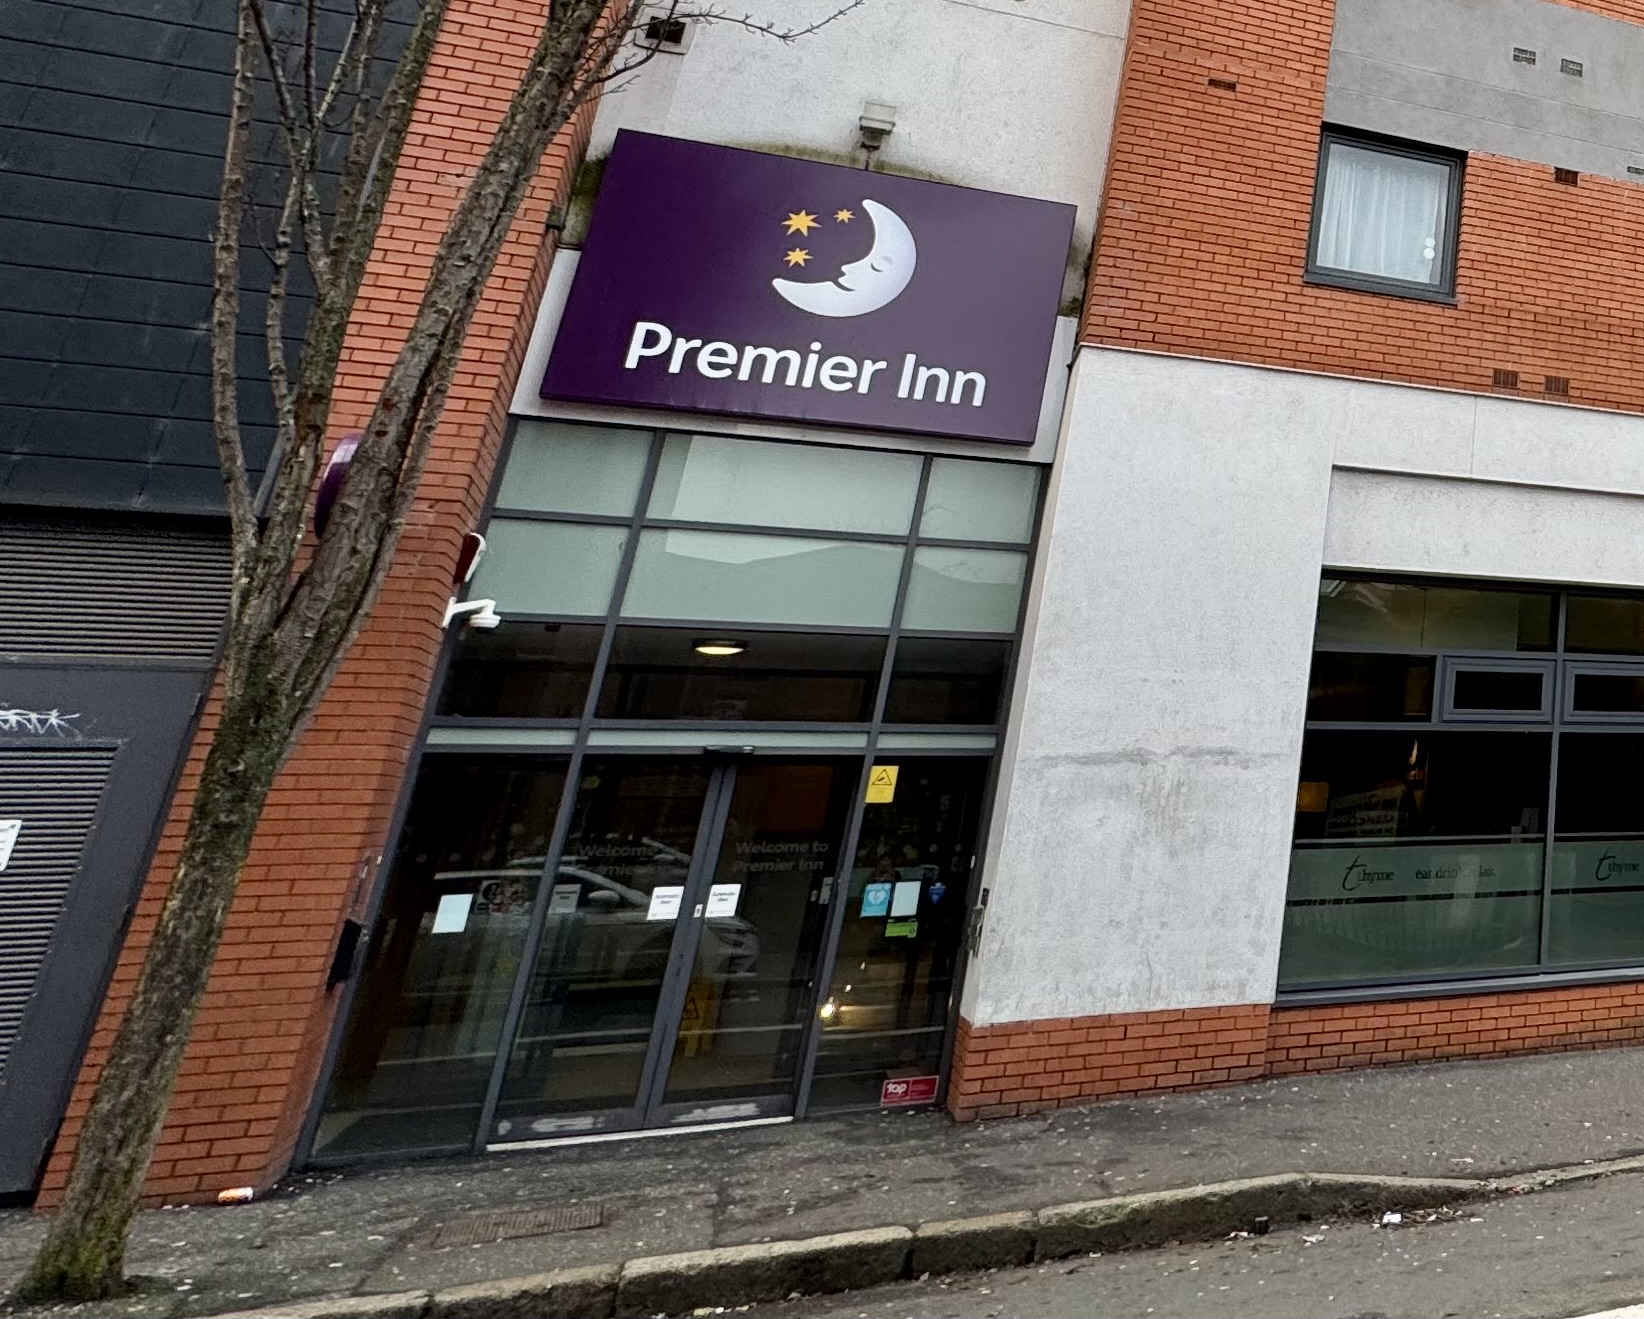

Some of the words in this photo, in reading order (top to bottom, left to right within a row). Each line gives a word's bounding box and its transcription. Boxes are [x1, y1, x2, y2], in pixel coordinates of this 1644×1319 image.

[624, 320, 887, 395] Premier
[897, 352, 987, 408] Inn
[735, 840, 810, 855] Welcome
[812, 839, 830, 853] to
[732, 858, 797, 873] Premier
[799, 858, 825, 872] Inn
